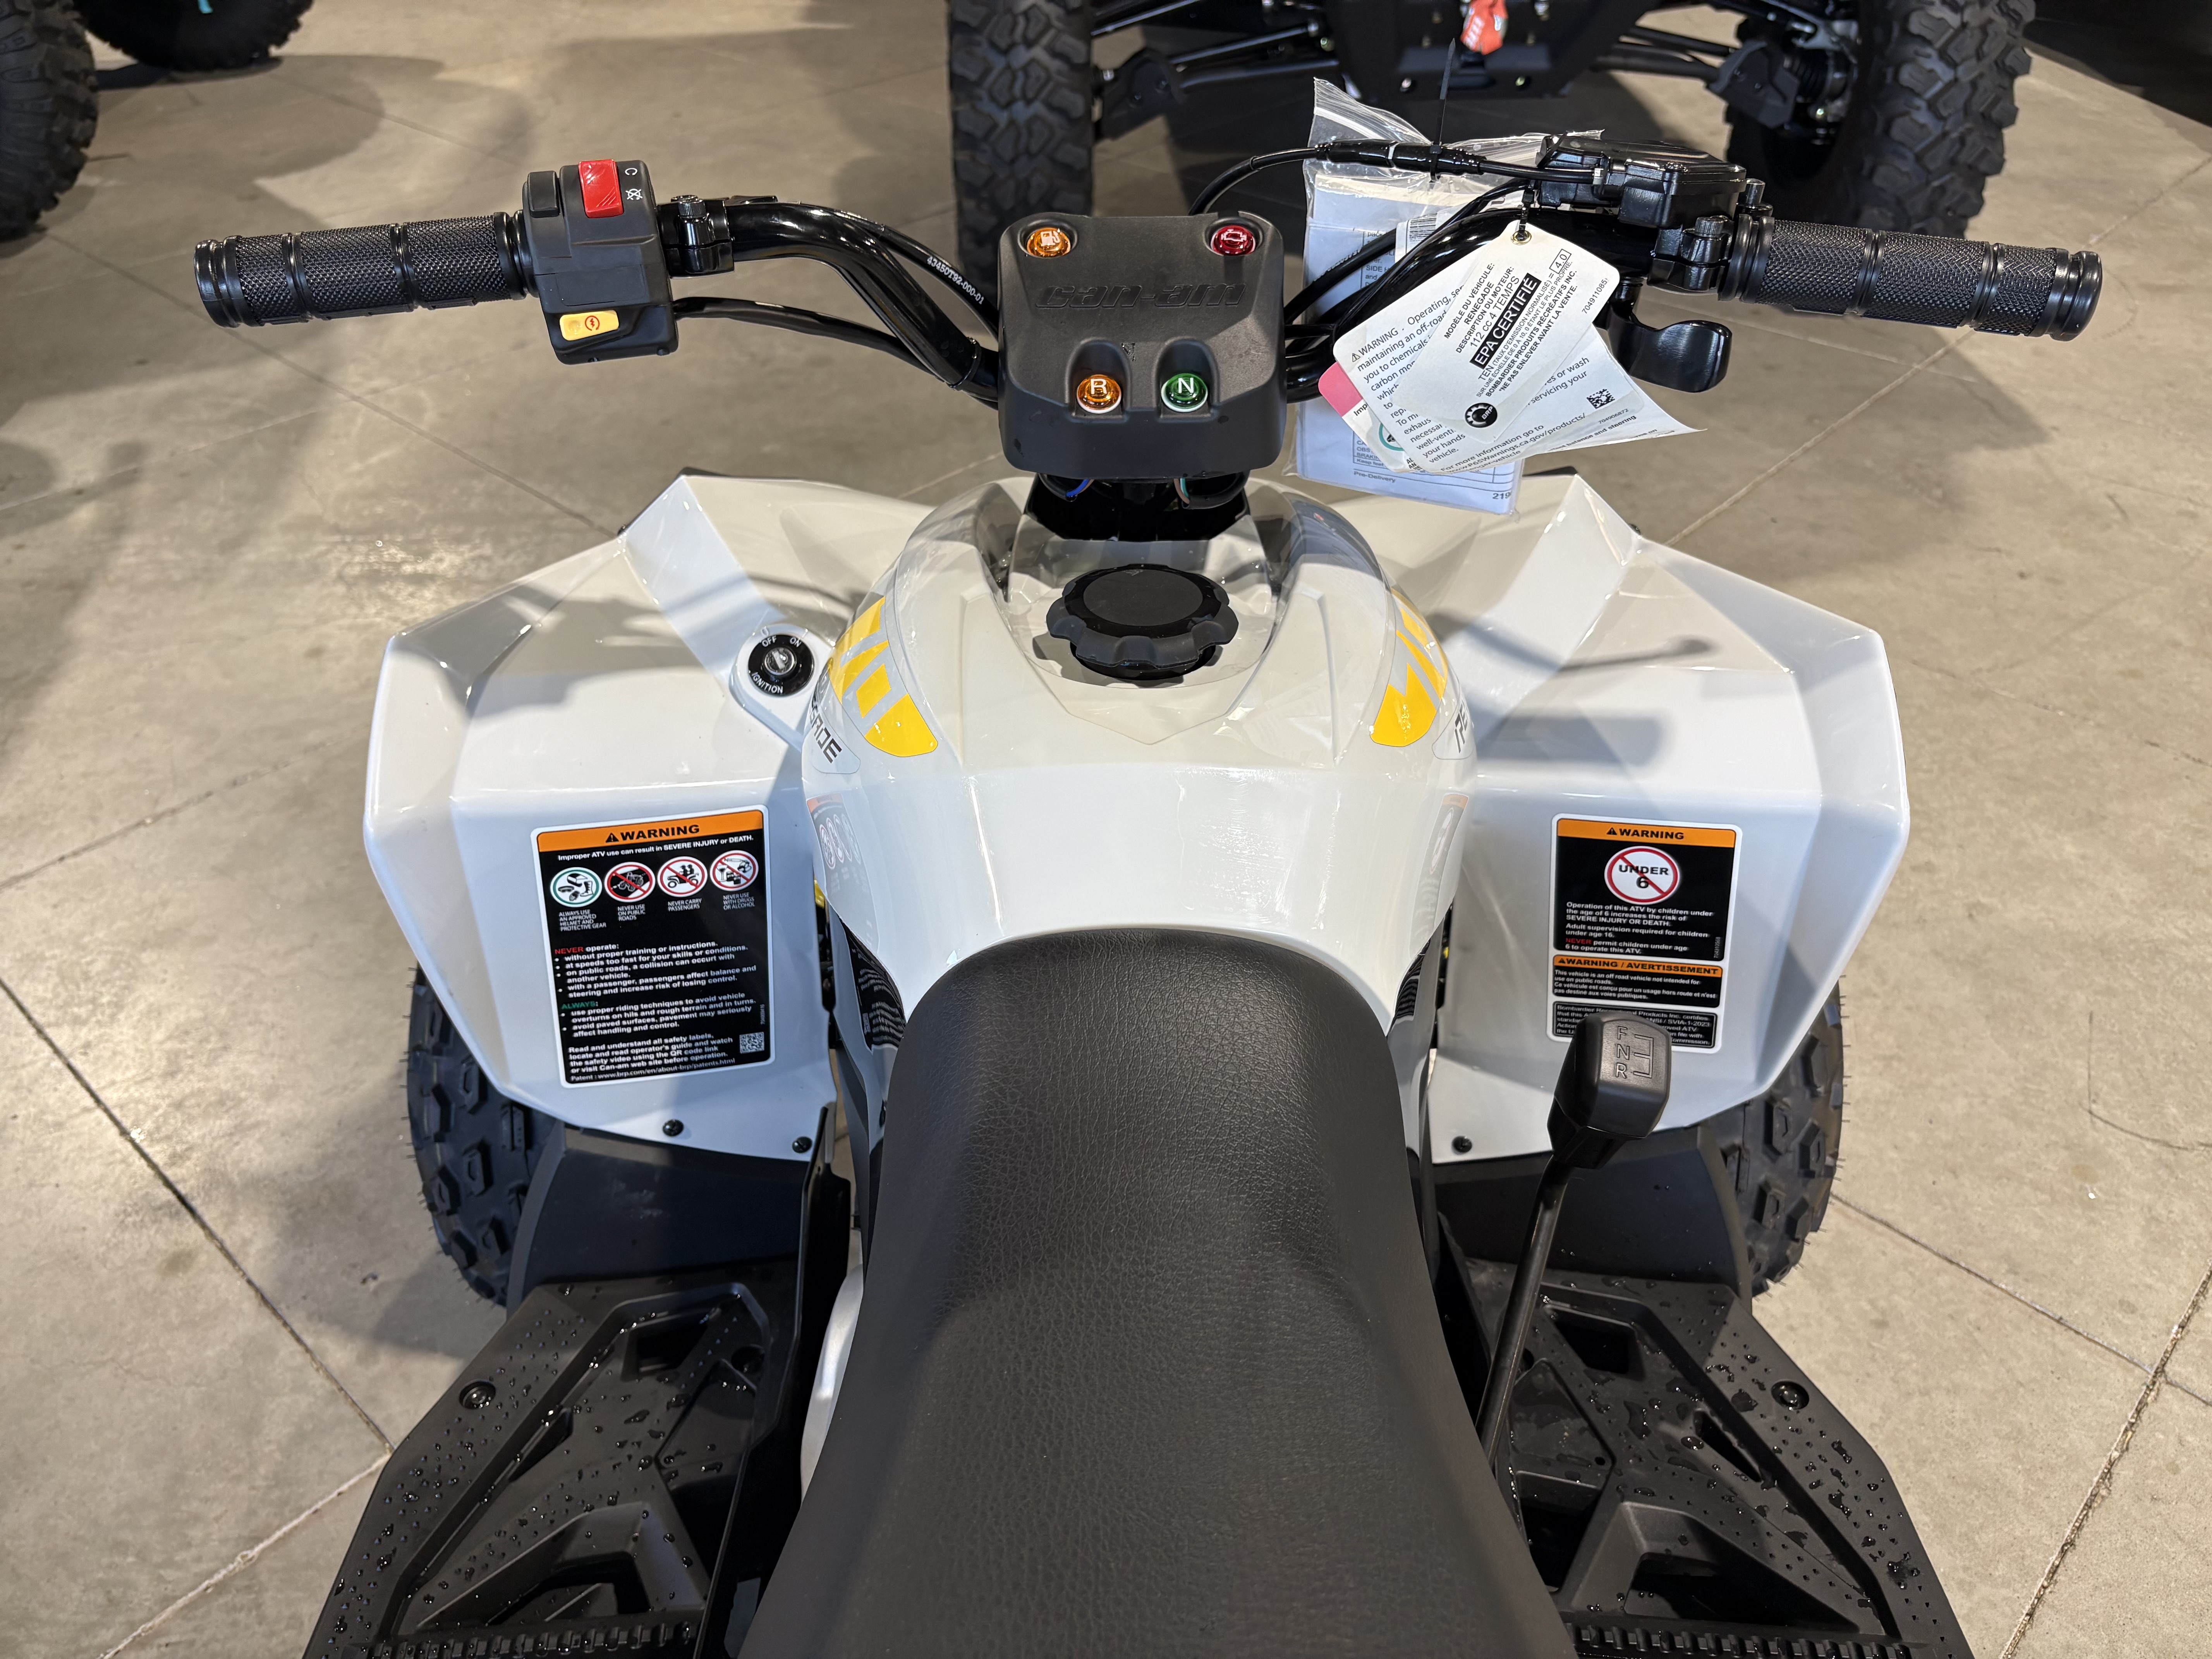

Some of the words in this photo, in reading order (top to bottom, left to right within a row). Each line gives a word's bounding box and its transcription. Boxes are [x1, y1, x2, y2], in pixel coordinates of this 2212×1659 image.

[1444, 309, 1465, 338] MODÈLE
[1462, 299, 1471, 310] DU
[1468, 263, 1494, 298] VÉHICULE:
[1463, 281, 1494, 325] RENEGADE
[1581, 279, 1607, 314] 704911085
[1455, 309, 1487, 353] DESCRIPTION
[1484, 298, 1493, 309] DU
[1491, 266, 1514, 298] MOTEUR:
[1470, 331, 1484, 347] 112
[1482, 320, 1492, 331] cc
[1492, 276, 1519, 310] TEMPS
[1478, 364, 1494, 380] TEN
[1492, 349, 1506, 366] (TAUX
[1503, 316, 1528, 350] D'EMISSION
[1525, 280, 1552, 317] NORMALISÉ)
[1555, 254, 1567, 268] 4.0
[1358, 327, 1398, 356] WARNING
[1407, 296, 1451, 325] Operating,
[1474, 341, 1498, 365] EPA
[1492, 277, 1537, 338] CERTIFIÉ
[1476, 387, 1486, 397] SUR
[1484, 377, 1494, 387] UNE
[1491, 355, 1510, 378] ÉCHELLE
[1507, 347, 1515, 356] DE
[1527, 308, 1540, 327] ÉTANT
[1539, 301, 1546, 309] LE
[1544, 285, 1556, 301] PLUS
[1553, 261, 1572, 285] PROPRE.
[1485, 359, 1517, 397] BOMBARDIER
[1514, 326, 1539, 359] PRODUITS
[1536, 284, 1566, 327] RÉCRÉATIFS
[1564, 271, 1577, 284] INC.
[1507, 369, 1518, 382] PAS
[1516, 341, 1540, 370] ENLEVER
[1537, 319, 1554, 342] AVANT
[1551, 310, 1561, 319] LA
[1558, 285, 1577, 308] VENTE.
[1357, 340, 1405, 371] maintaining
[1404, 333, 1415, 342] an
[1556, 369, 1565, 378] or
[1566, 357, 1589, 372] wash
[1363, 369, 1379, 383] you
[1371, 372, 1398, 391] carbon
[1567, 371, 1587, 386] your
[1091, 378, 1107, 394] R
[1178, 377, 1194, 393] N
[1481, 406, 1496, 419] BRP
[1422, 446, 1440, 458] your
[1440, 434, 1465, 448] hands
[1455, 456, 1475, 466] more
[1475, 435, 1522, 457] information
[1429, 448, 1458, 462] vehicle.
[1353, 471, 1396, 483] Pre-Delivery
[762, 635, 777, 647] OFF
[789, 637, 802, 648] ON
[751, 671, 783, 694] IGNITION
[620, 824, 699, 841] WARNING
[1619, 828, 1684, 840] WARNING
[663, 842, 692, 850] SEVERE
[693, 838, 718, 847] INJURY
[728, 835, 753, 843] DEATH.
[1619, 864, 1668, 875] UNDER
[1636, 875, 1650, 888] 6
[1566, 901, 1603, 909] Operation
[564, 953, 595, 961] without
[596, 951, 624, 959] proper
[625, 947, 656, 955] training
[668, 941, 718, 951] instructions.
[585, 944, 619, 952] operate:
[1566, 958, 1618, 967] WARNING
[1626, 963, 1718, 974] AVERTISSEMENT
[562, 1001, 598, 1009] ALWAYS:
[597, 1026, 632, 1035] handling
[649, 1021, 679, 1029] control.
[1617, 1026, 1628, 1040] F
[1617, 1044, 1630, 1060] N
[1615, 1063, 1627, 1079] R
